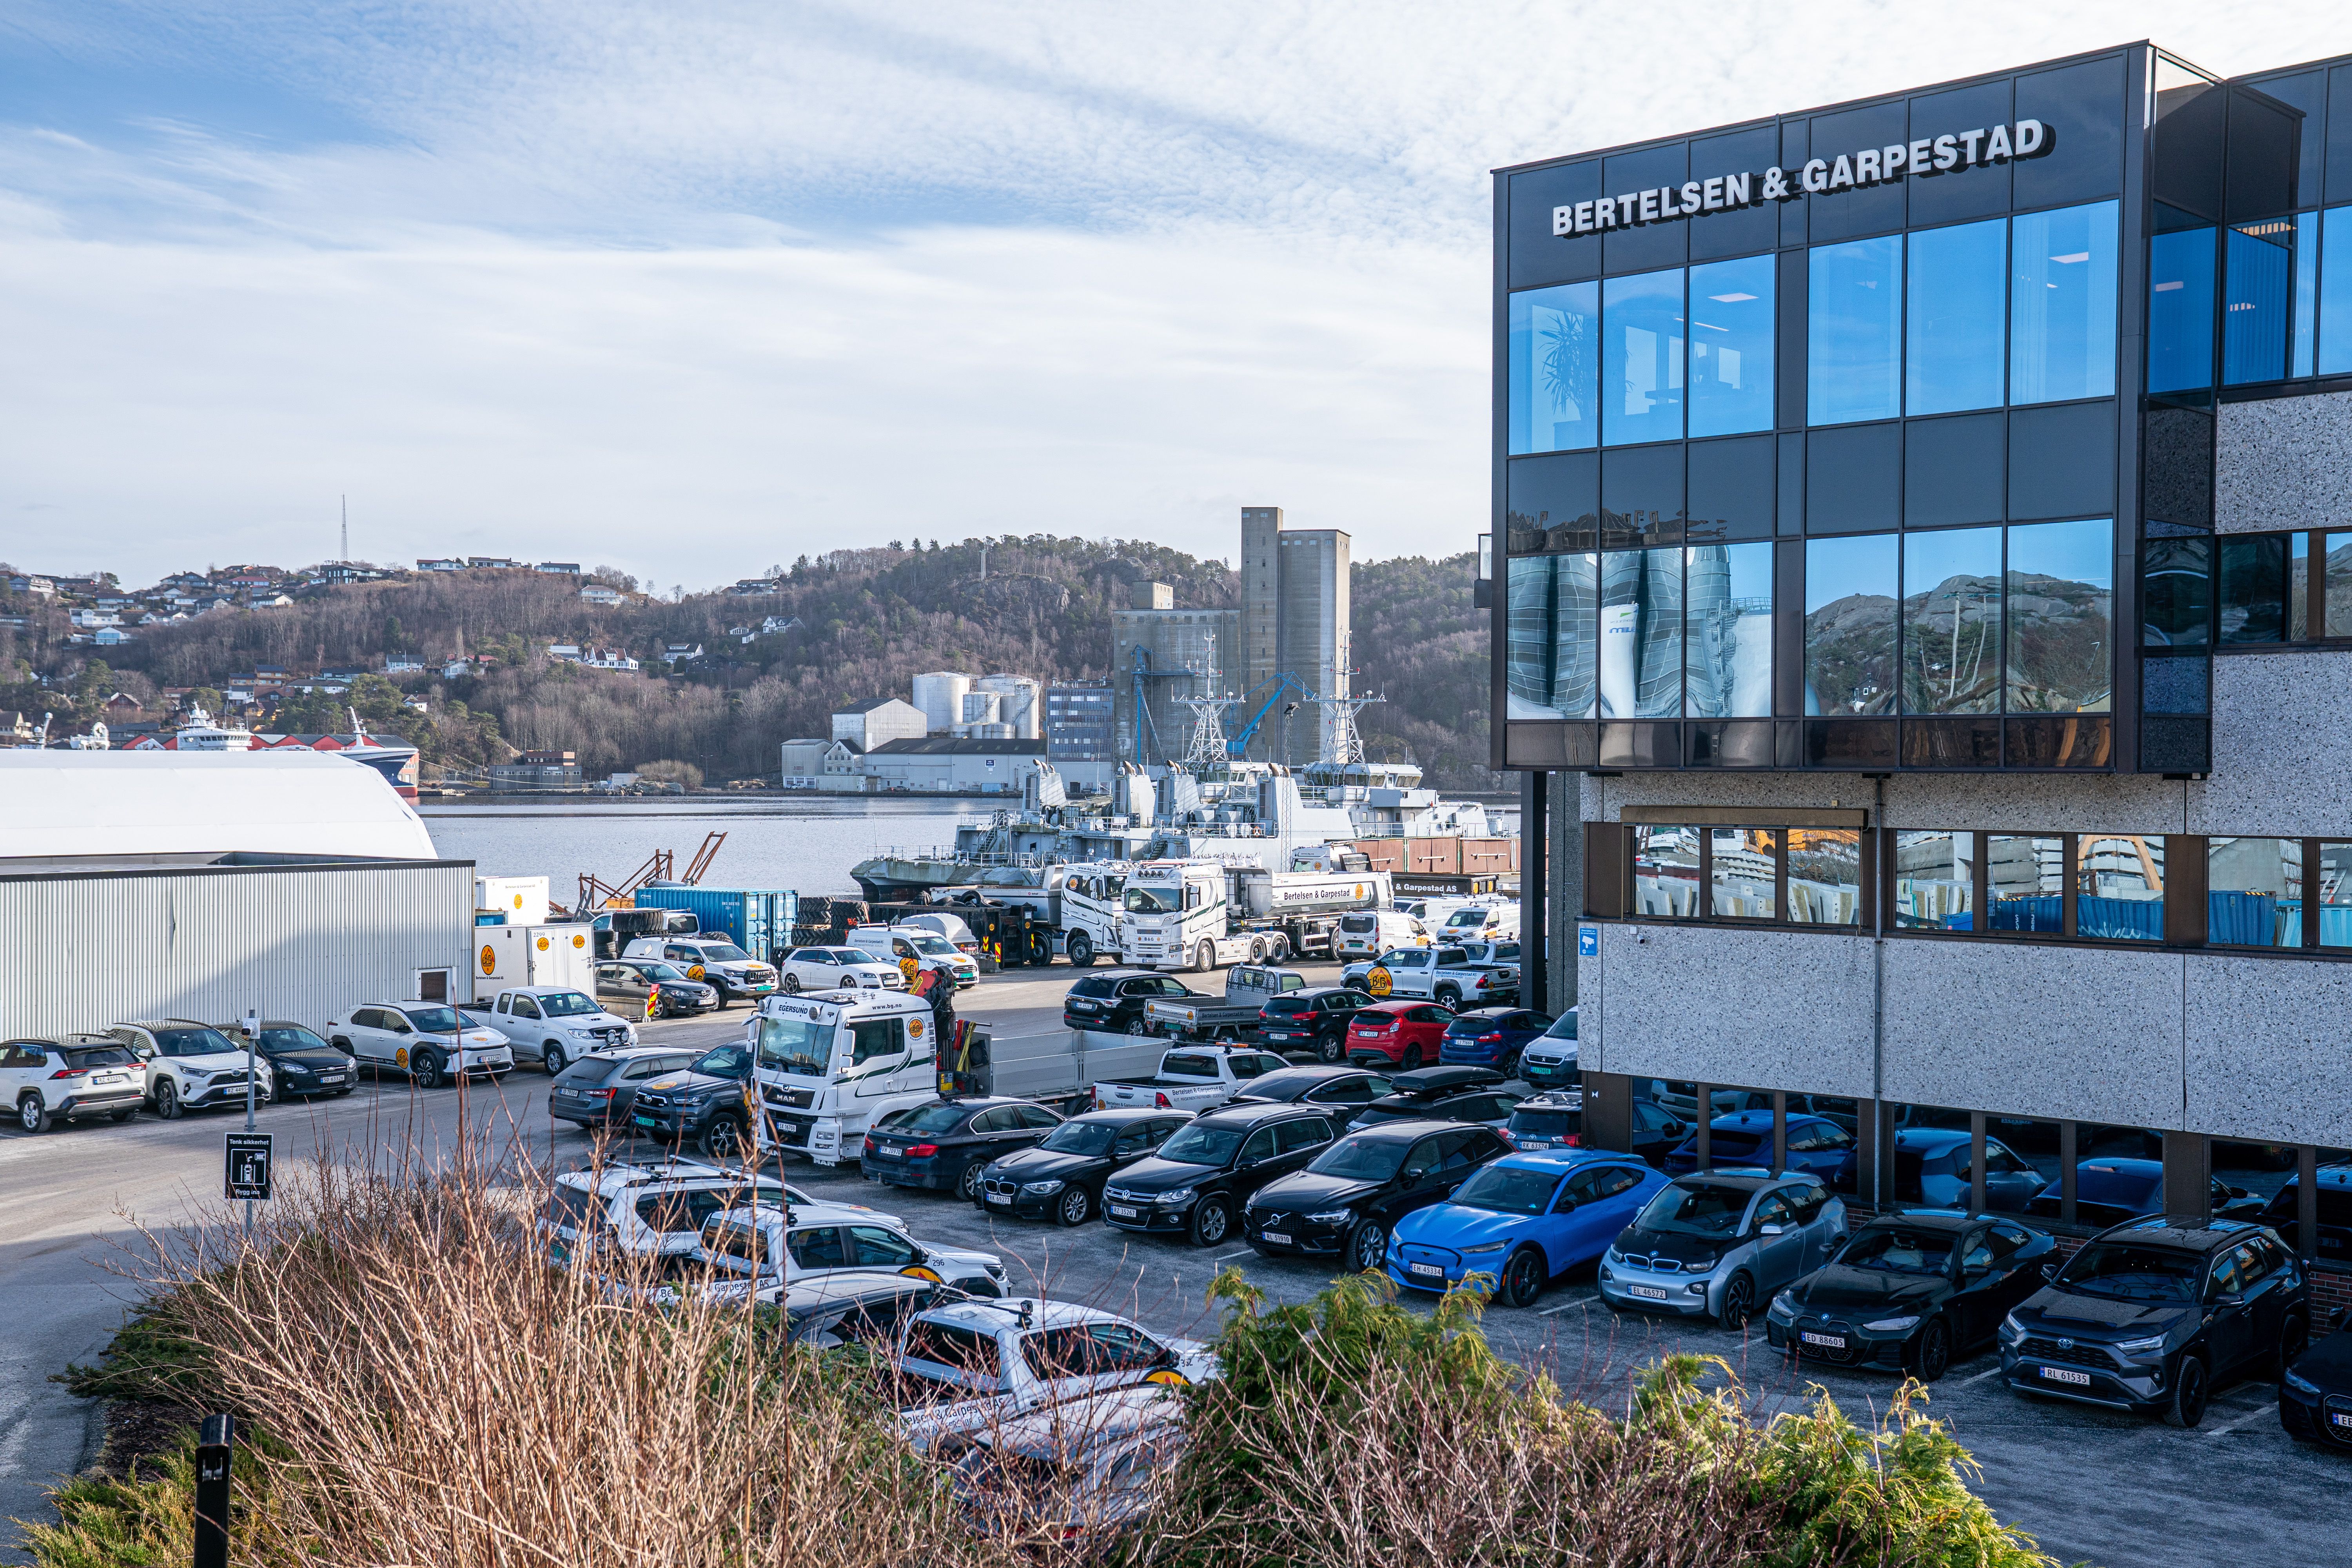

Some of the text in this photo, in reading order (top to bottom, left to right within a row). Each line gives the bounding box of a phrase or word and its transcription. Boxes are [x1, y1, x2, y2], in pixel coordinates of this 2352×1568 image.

[1553, 119, 2045, 236] BERTELSEN & GARPESTAD
[1404, 884, 1445, 893] Garpestad
[1284, 891, 1314, 900] Bertelsen
[1321, 888, 1349, 899] Garpestad
[779, 1005, 808, 1014] EGERSUND
[777, 1094, 795, 1103] MAN
[814, 1158, 835, 1167] MAN
[1423, 1266, 1441, 1275] 45334
[715, 1280, 769, 1294] Garpesta AS
[1643, 1289, 1663, 1298] 46572
[1807, 1334, 1843, 1346] ED 88605
[2048, 1369, 2087, 1383] RL 61535
